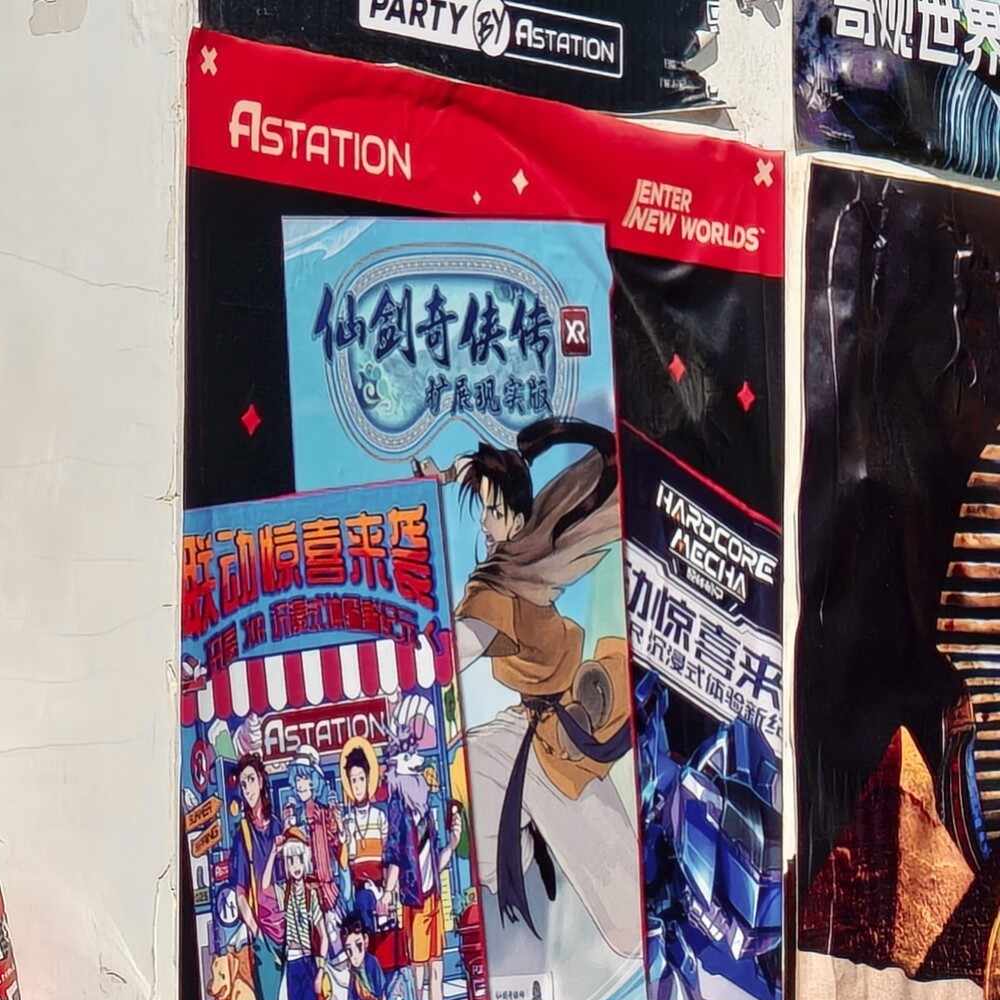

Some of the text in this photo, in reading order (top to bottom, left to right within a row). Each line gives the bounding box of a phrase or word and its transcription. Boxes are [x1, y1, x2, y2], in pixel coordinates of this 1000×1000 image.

[369, 0, 467, 35] PARTY
[515, 18, 616, 64] ASTATION
[229, 99, 413, 182] ASTATION
[625, 205, 677, 237] NEW
[636, 178, 694, 214] ENTER
[564, 319, 587, 345] XR
[656, 484, 778, 585] HARDCORE
[670, 528, 747, 601] MECHA
